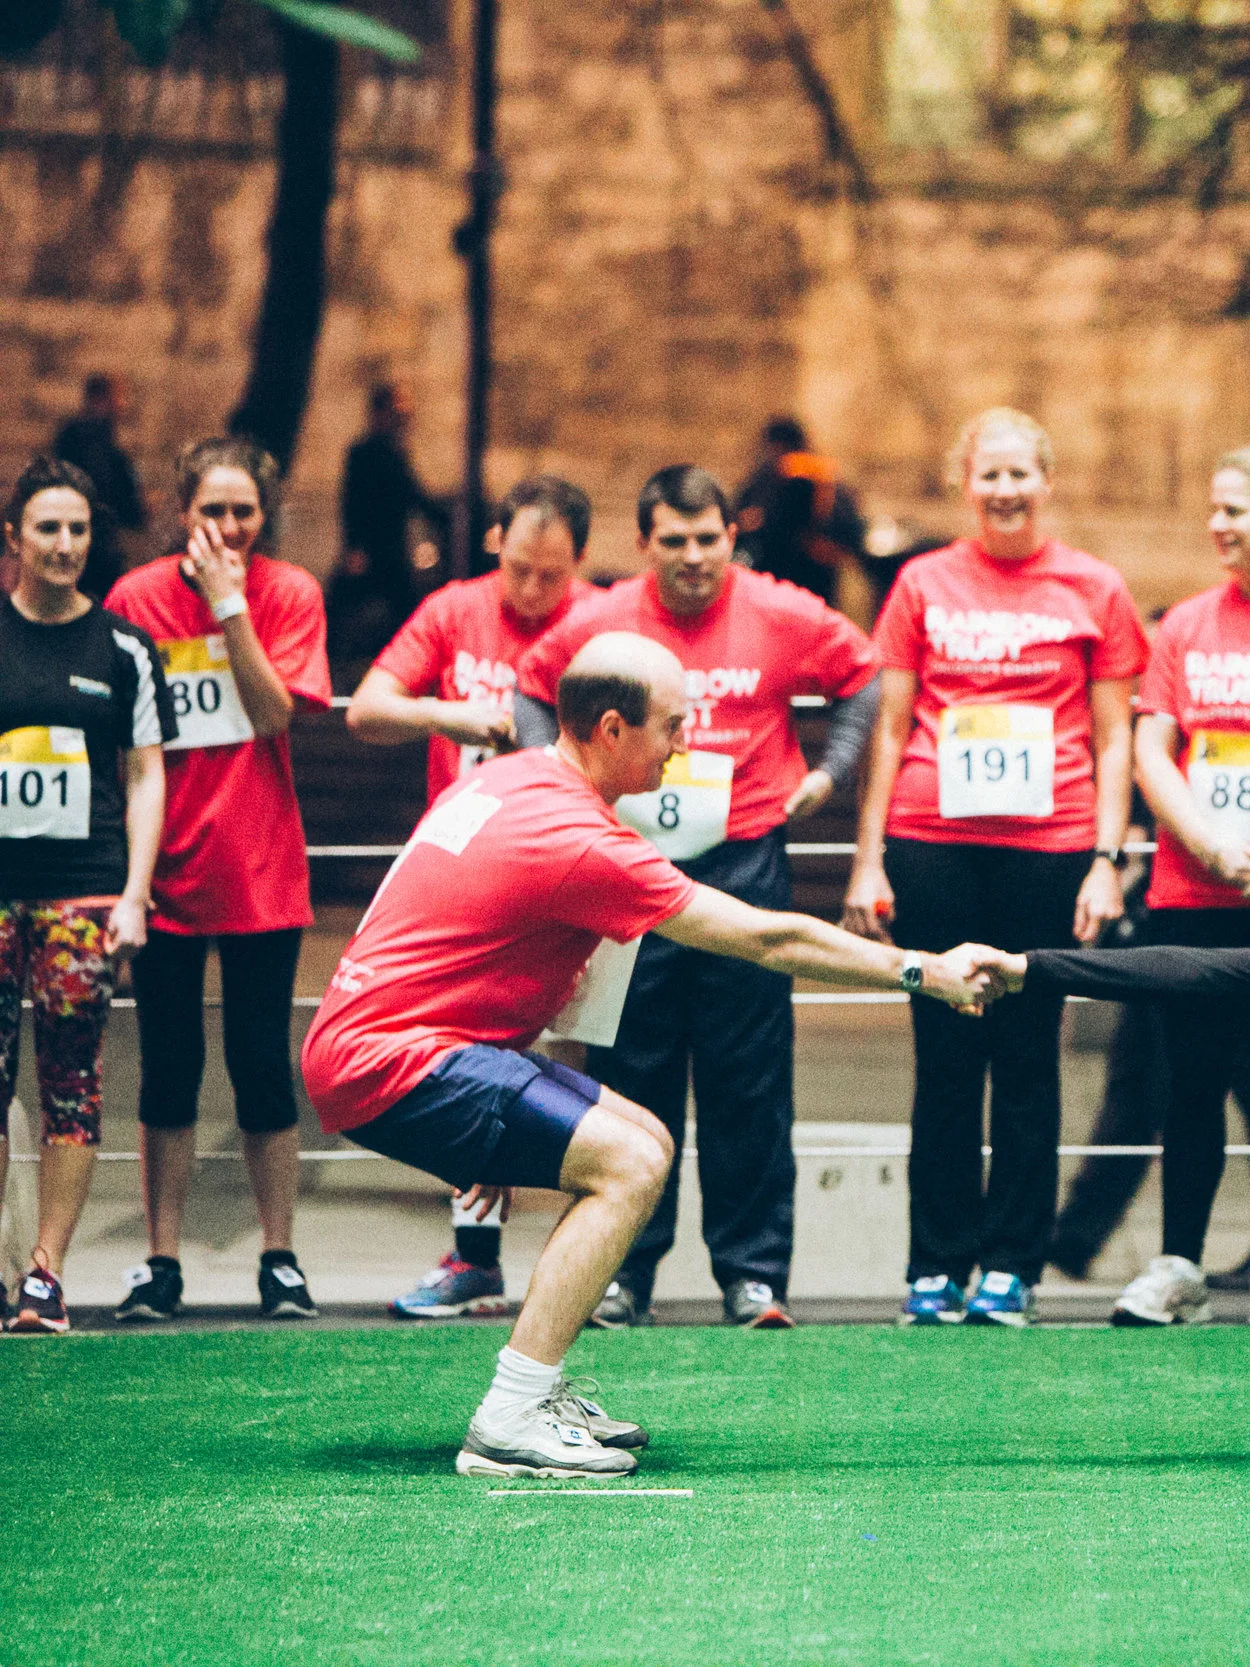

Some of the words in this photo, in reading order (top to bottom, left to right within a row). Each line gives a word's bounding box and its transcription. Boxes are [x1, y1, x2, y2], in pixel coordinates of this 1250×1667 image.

[957, 748, 1033, 783] 191
[0, 770, 68, 807] 101
[658, 792, 679, 830] 8
